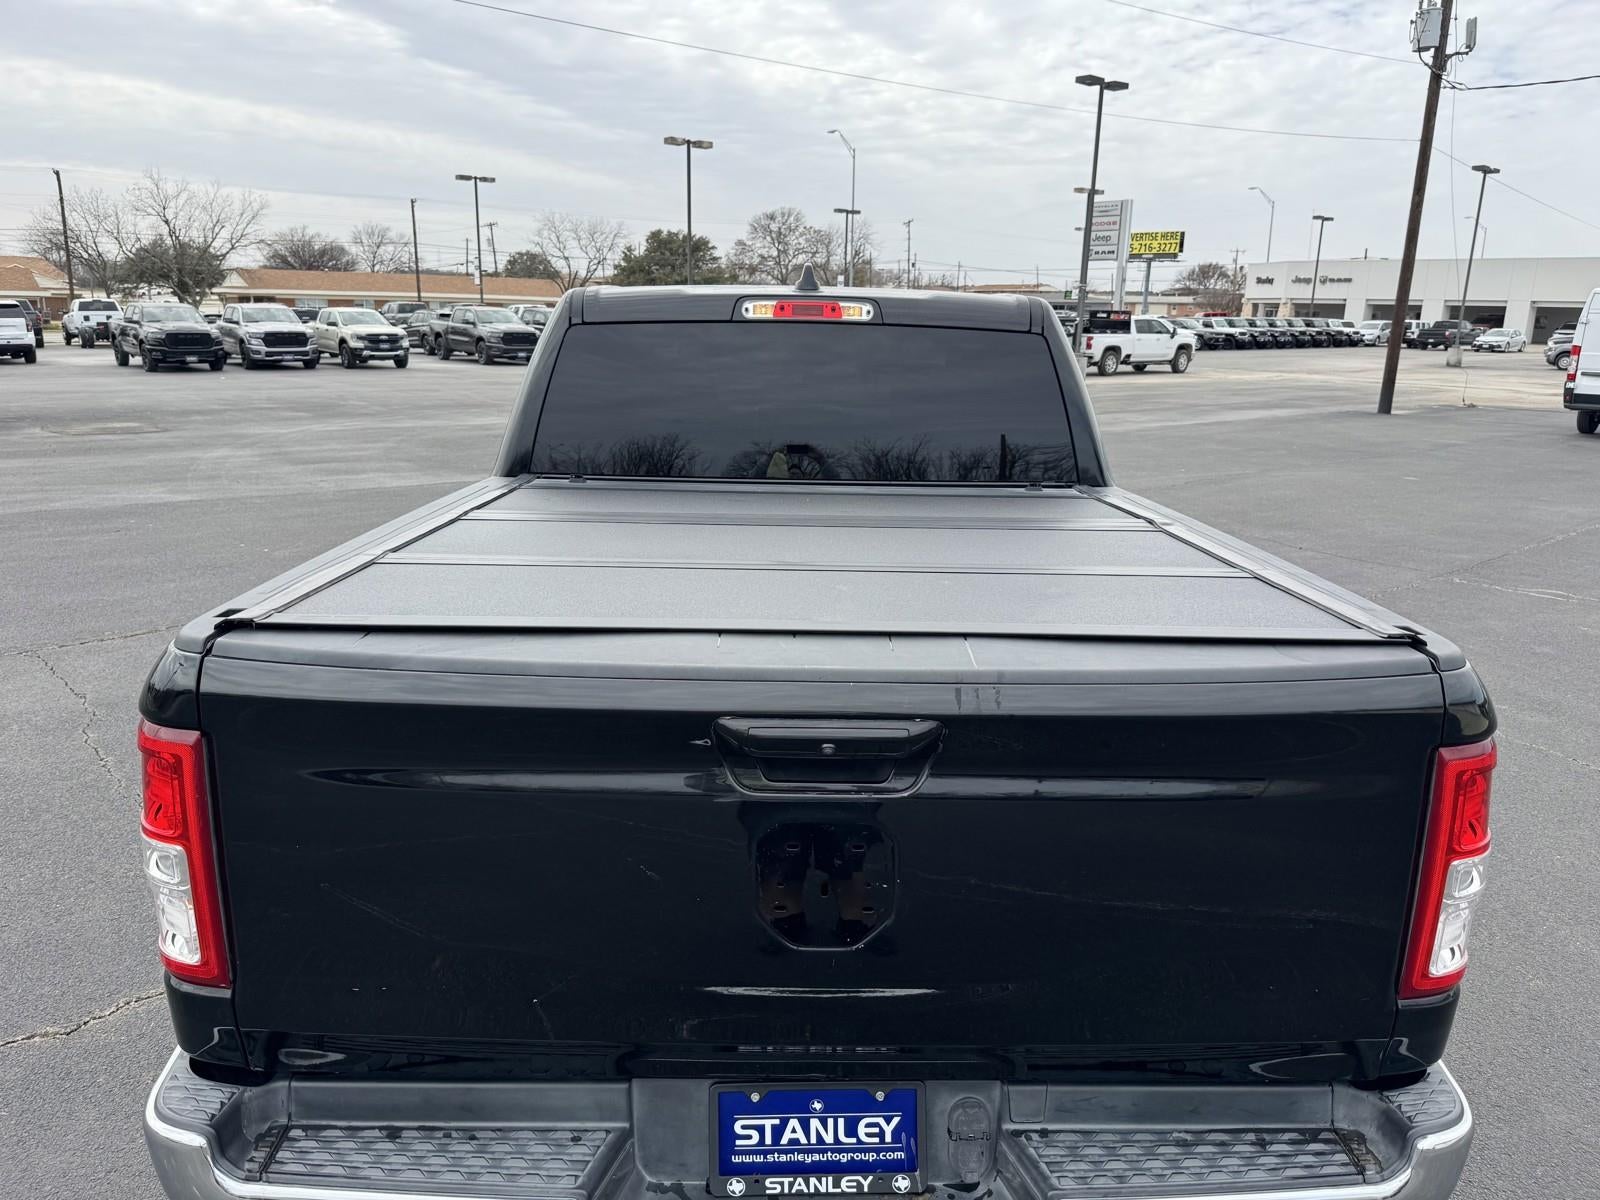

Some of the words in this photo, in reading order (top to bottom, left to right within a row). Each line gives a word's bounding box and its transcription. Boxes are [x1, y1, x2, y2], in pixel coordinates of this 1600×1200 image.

[1092, 233, 1112, 243] Jeep
[1130, 232, 1159, 242] VERTISE
[1160, 231, 1180, 241] HERE
[1129, 242, 1178, 253] 5-716-3277
[734, 1116, 901, 1146] STANLEY
[731, 1151, 905, 1163] www.stanleyautogroup.com
[764, 1175, 873, 1194] STANLEY
